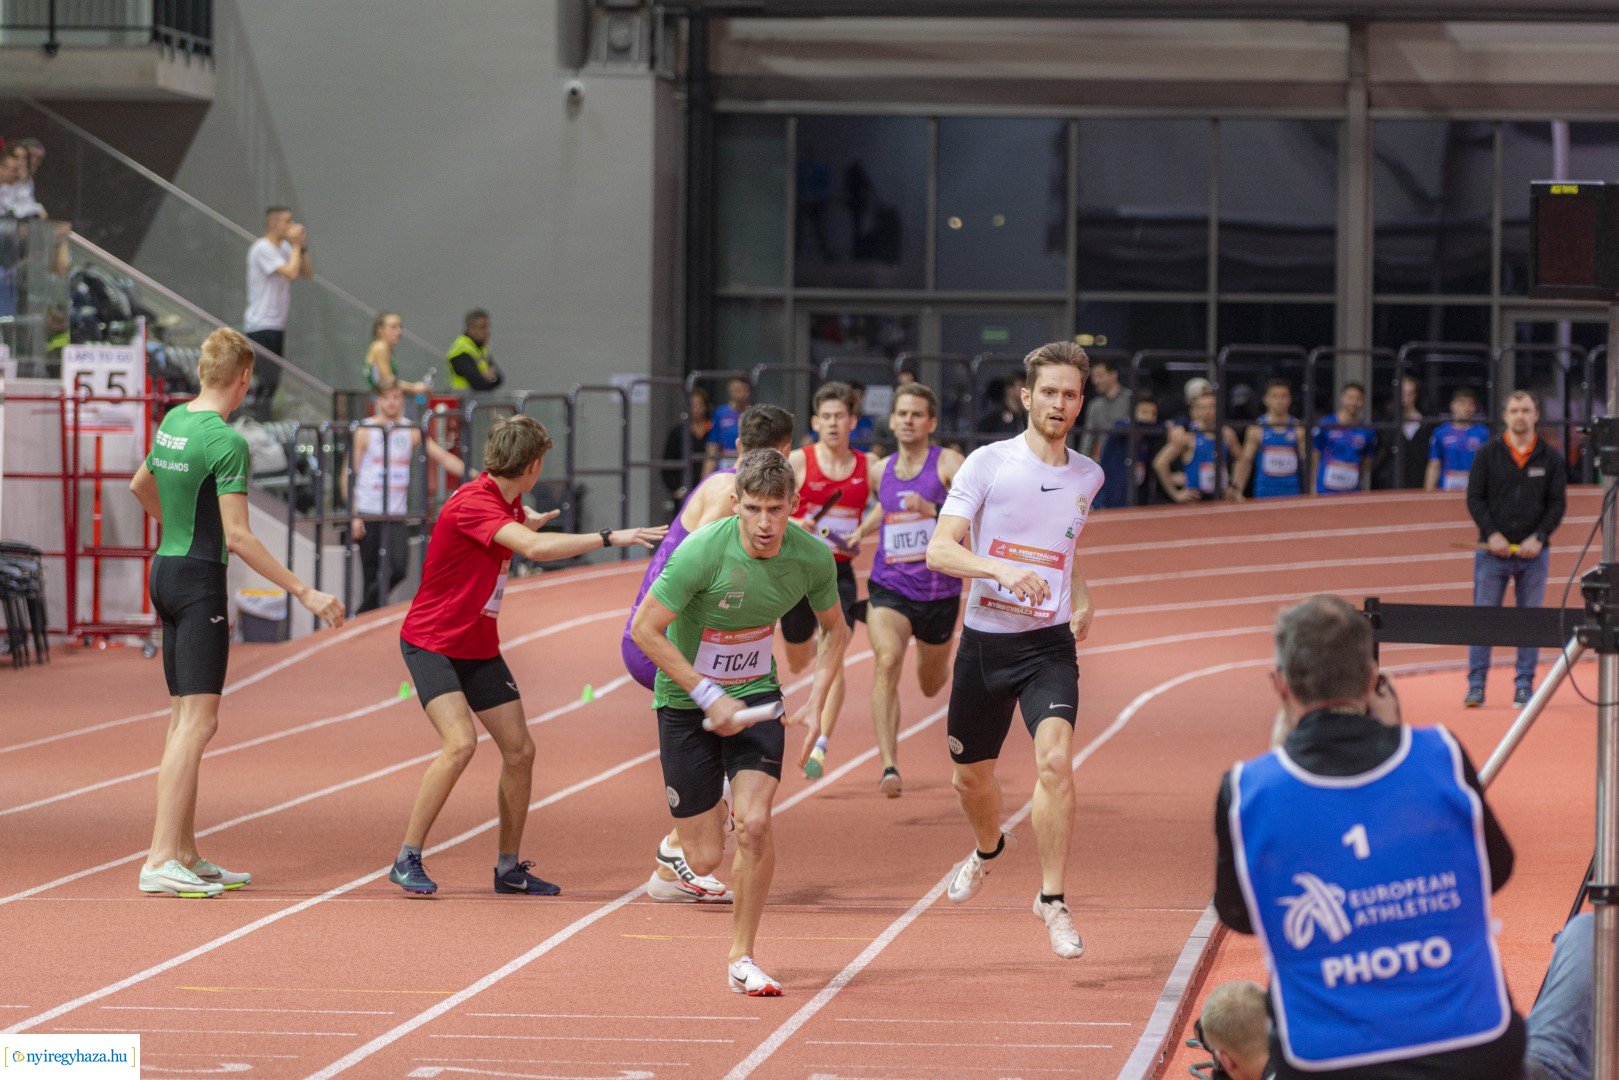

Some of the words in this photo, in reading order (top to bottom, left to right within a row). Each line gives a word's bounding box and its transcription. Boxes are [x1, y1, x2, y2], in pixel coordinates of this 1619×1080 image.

[68, 351, 96, 361] LAPS
[99, 351, 113, 361] TO
[116, 352, 133, 362] GO
[893, 530, 928, 549] UTE/3
[712, 650, 760, 672] FTC/4
[1341, 823, 1371, 860] 1
[1348, 871, 1457, 910] EUROPEAN
[1354, 888, 1461, 928] ATHLETICS
[1321, 935, 1452, 988] PHOTO
